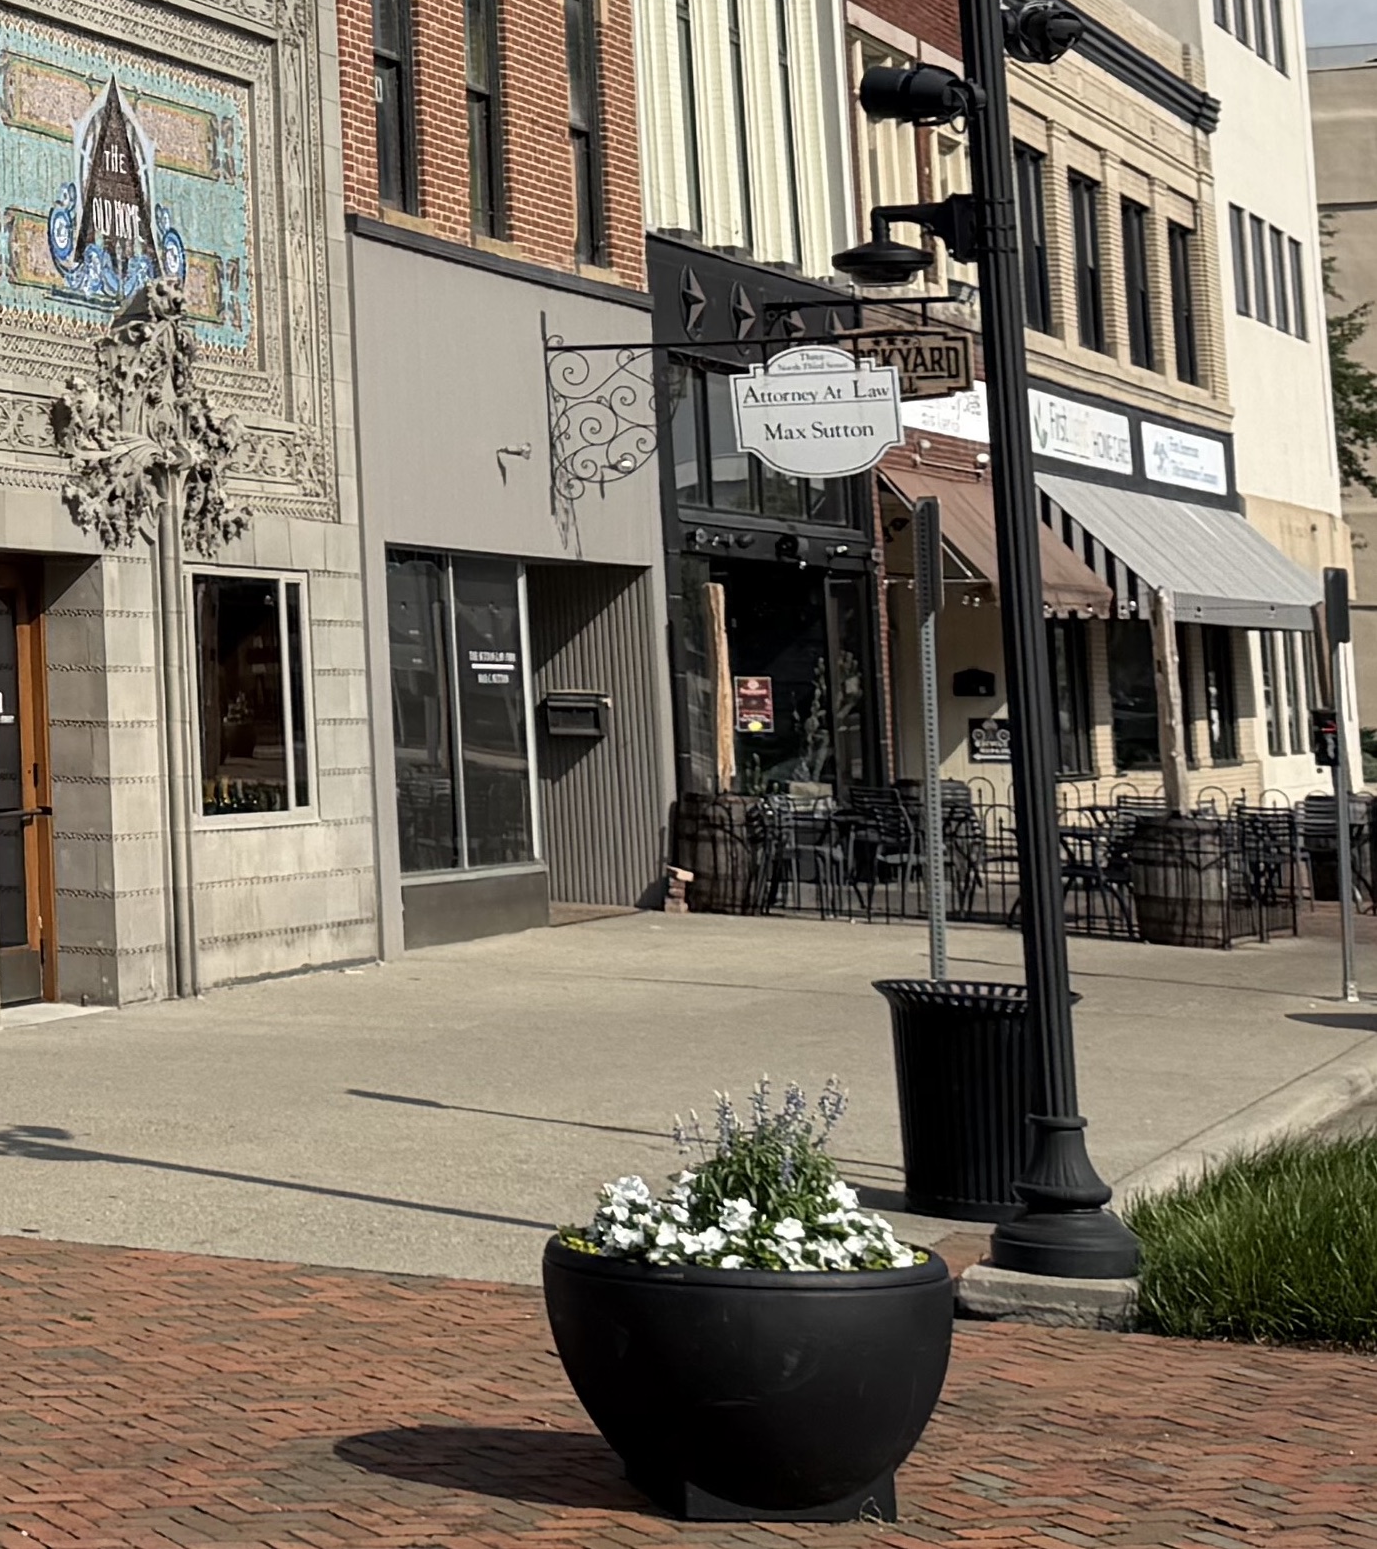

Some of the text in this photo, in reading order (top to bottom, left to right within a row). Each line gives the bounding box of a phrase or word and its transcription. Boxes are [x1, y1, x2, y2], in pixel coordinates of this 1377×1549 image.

[104, 145, 127, 175] THE
[92, 197, 144, 242] OLD HOME
[743, 386, 818, 404] Attorney
[823, 386, 842, 400] At
[852, 380, 890, 398] Law
[764, 421, 875, 441] Max Sutton
